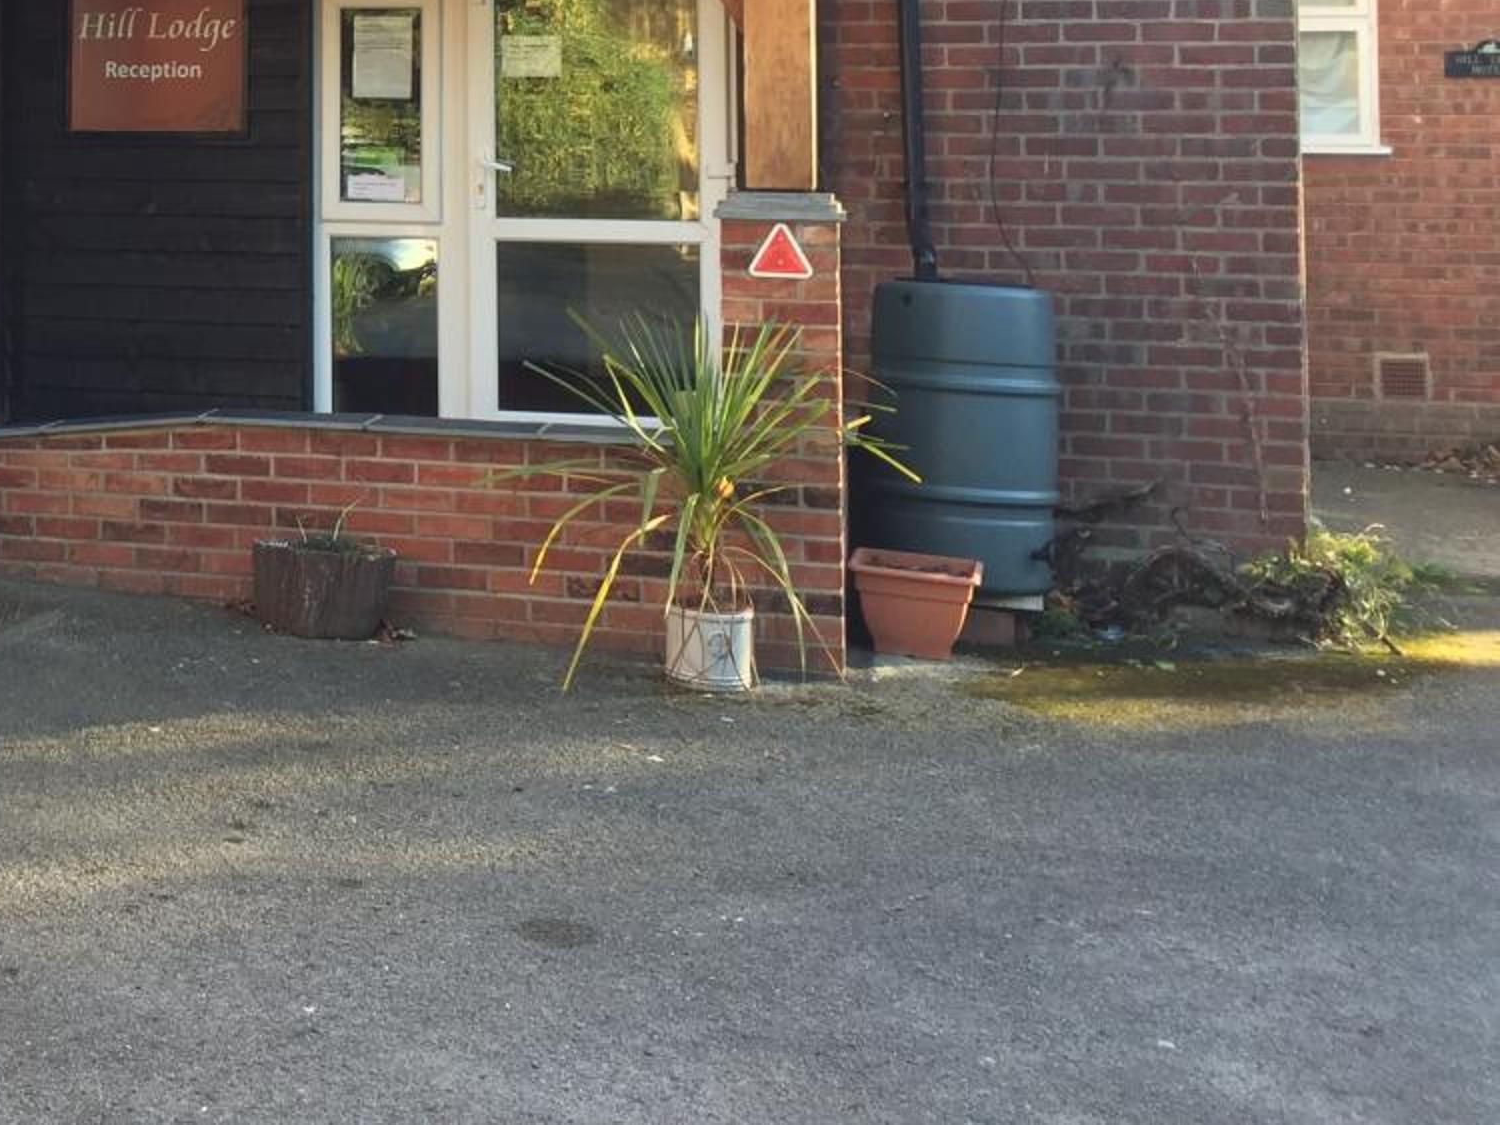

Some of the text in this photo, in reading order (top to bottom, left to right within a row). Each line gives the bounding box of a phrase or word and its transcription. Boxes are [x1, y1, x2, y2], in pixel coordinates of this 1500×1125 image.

[78, 6, 237, 52] Hill Lodge
[104, 60, 202, 81] Reception
